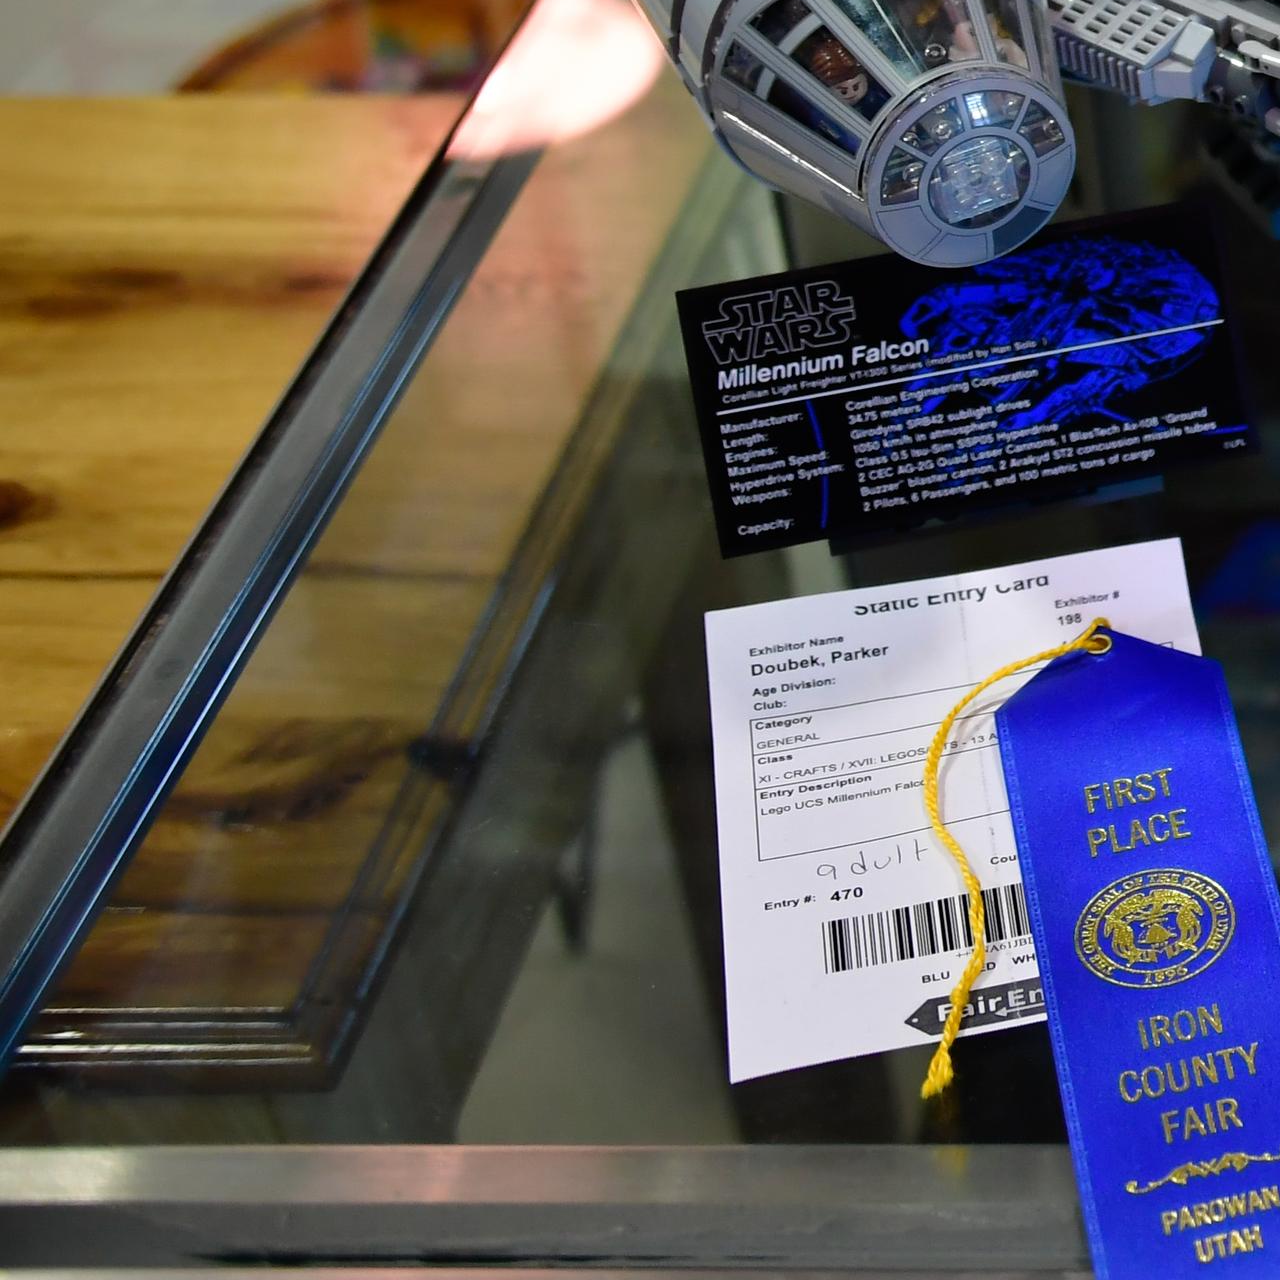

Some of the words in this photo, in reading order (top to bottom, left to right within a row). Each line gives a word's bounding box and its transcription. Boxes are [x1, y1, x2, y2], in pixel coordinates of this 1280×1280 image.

[702, 280, 854, 334] STAR
[704, 309, 856, 365] WARS
[718, 353, 844, 390] Millennium
[852, 338, 929, 366] Falcon
[720, 413, 803, 434] Manufacturer:
[845, 394, 898, 411] Corellian
[899, 381, 970, 401] Engineering
[971, 369, 1039, 389] Corporation
[723, 433, 768, 449] Length:
[880, 404, 922, 419] meters
[725, 446, 778, 464] Engines:
[947, 405, 993, 422] sublight
[995, 399, 1032, 413] drives
[727, 459, 786, 477] Maximum
[788, 451, 829, 467] Speed:
[929, 420, 998, 440] atmosphere
[730, 472, 795, 493] Hyperdrive
[798, 464, 845, 480] System:
[855, 456, 889, 469] Class
[996, 423, 1059, 442] Hyperdrive
[907, 472, 948, 487] blaster
[1076, 436, 1141, 455] concussion
[1142, 428, 1183, 442] missile
[1184, 420, 1217, 434] tubes
[732, 488, 792, 506] Weapons:
[936, 453, 969, 467] Quad
[970, 448, 1003, 461] Laser
[738, 519, 794, 536] Capacity:
[994, 474, 1017, 487] and
[1041, 463, 1079, 478] metric
[1080, 457, 1106, 470] tons
[1107, 453, 1120, 464] of
[1122, 449, 1156, 463] cargo
[1055, 591, 1109, 609] Exhibitor
[1112, 590, 1120, 599] #
[1057, 613, 1082, 626] 198
[750, 641, 805, 657] Exhibitor
[809, 635, 844, 648] Name
[751, 655, 826, 677] Doubek,
[831, 646, 888, 664] Parker
[752, 685, 777, 697] Age
[781, 677, 836, 693] Division:
[753, 700, 787, 711] Club:
[755, 715, 813, 731] Category
[756, 733, 820, 750] GENERAL
[757, 753, 793, 765] Class
[758, 774, 771, 784] XI
[783, 763, 837, 780] CRAFTS
[848, 758, 877, 770] XVII:
[971, 734, 985, 744] 13
[760, 787, 794, 800] Entry
[798, 774, 872, 793] Description
[760, 804, 791, 816] Lego
[795, 798, 823, 810] UCS
[827, 786, 891, 805] Millennium
[1084, 767, 1173, 814] FIRST
[1087, 808, 1191, 858] PLACE
[1124, 876, 1143, 890] OF
[1148, 874, 1180, 885] THE
[1183, 875, 1219, 903] STATE
[764, 897, 800, 911] Entry
[804, 895, 816, 903] #:
[830, 887, 863, 902] 470
[1091, 886, 1122, 914] SEAL
[1215, 901, 1228, 916] OF
[1081, 915, 1096, 954] GREAT
[1206, 916, 1229, 950] UTAH
[922, 971, 950, 983] BLU
[1090, 952, 1114, 976] THE
[1143, 966, 1189, 985] 1896
[1137, 1003, 1223, 1050] IRON
[1118, 1041, 1259, 1103] COUNTY
[1161, 1098, 1244, 1144] FAIR
[1194, 1224, 1264, 1263] UTAH
